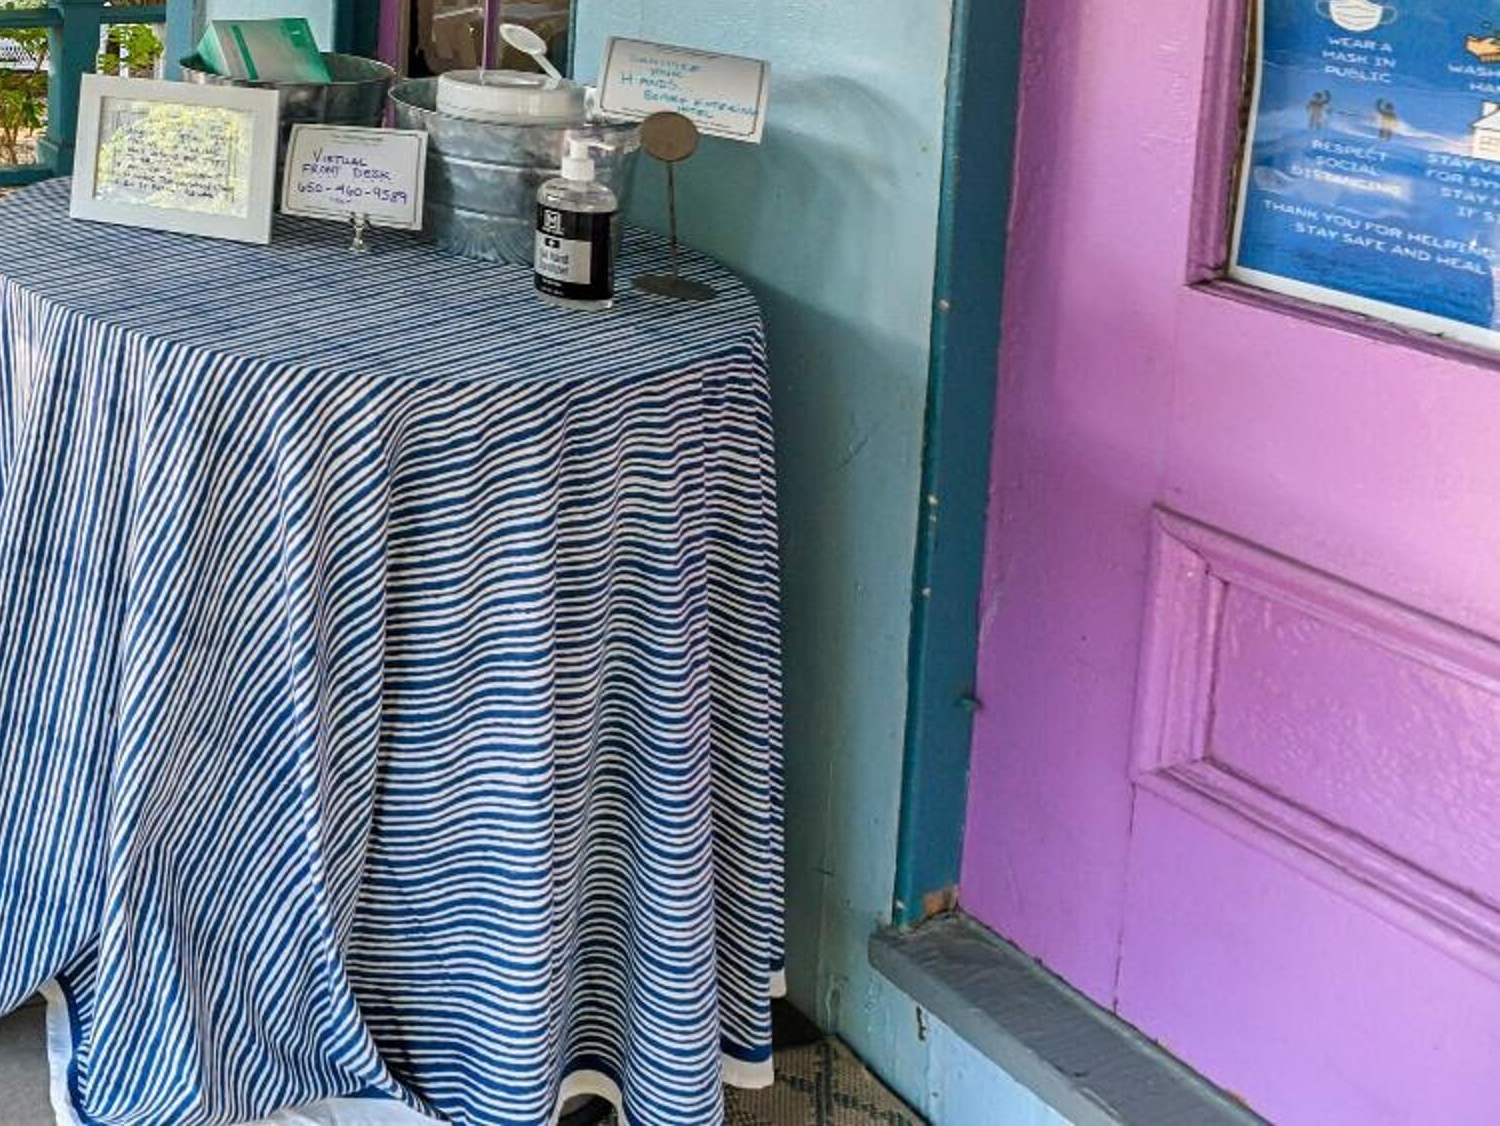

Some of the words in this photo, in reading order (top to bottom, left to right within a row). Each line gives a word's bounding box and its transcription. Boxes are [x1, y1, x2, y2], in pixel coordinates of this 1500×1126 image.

[1327, 36, 1375, 50] WEAR
[1379, 40, 1393, 53] A
[1321, 49, 1367, 64] MASK
[1373, 56, 1396, 68] IN
[1324, 64, 1392, 83] PUBLIC
[1315, 155, 1380, 175] SOCIAL
[1427, 152, 1476, 171] STAY
[1263, 198, 1319, 220] THANK
[1325, 212, 1360, 229] YOU
[1364, 220, 1403, 238] FOR
[1295, 220, 1338, 240] STAY
[1342, 232, 1387, 252] SAFE
[1390, 243, 1431, 262] AND
